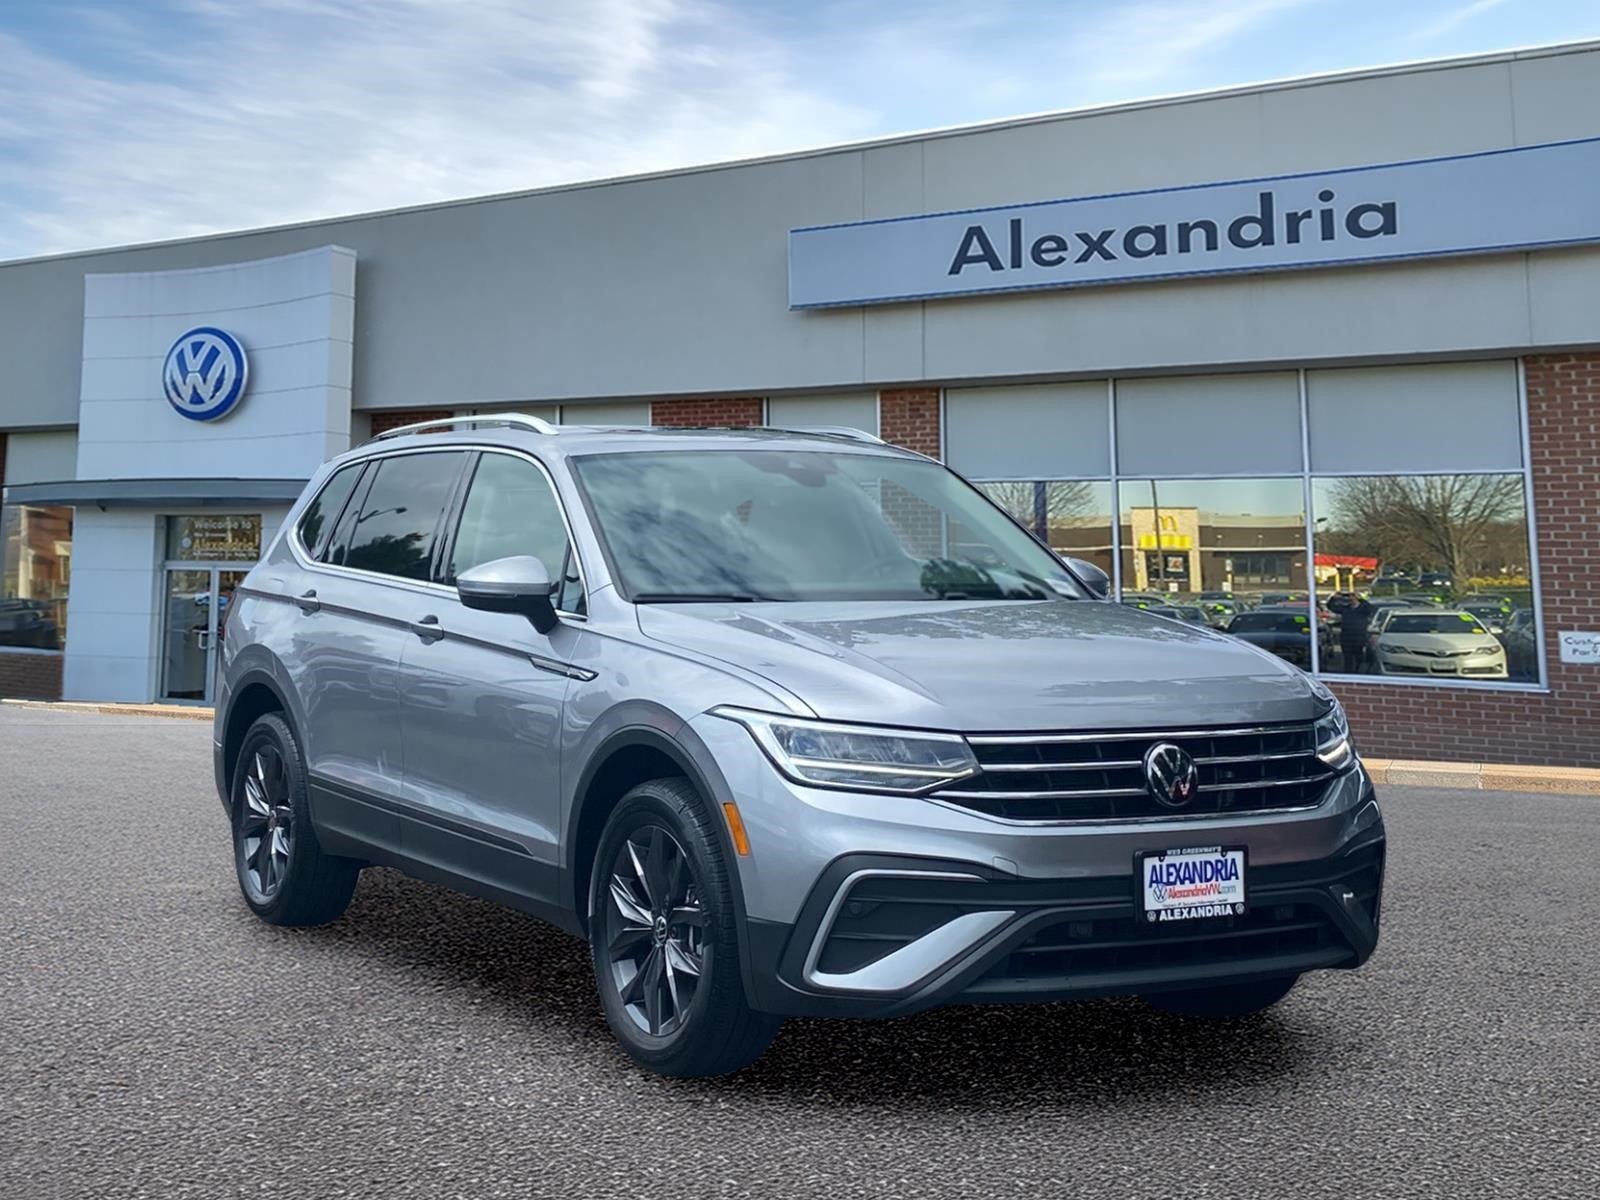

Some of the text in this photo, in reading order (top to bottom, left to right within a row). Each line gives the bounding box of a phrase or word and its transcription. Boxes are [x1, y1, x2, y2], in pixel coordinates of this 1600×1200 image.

[948, 189, 1398, 275] Alexandria
[1149, 858, 1239, 888] ALEXANDRIA
[1159, 904, 1233, 921] ALEXANDRIA
